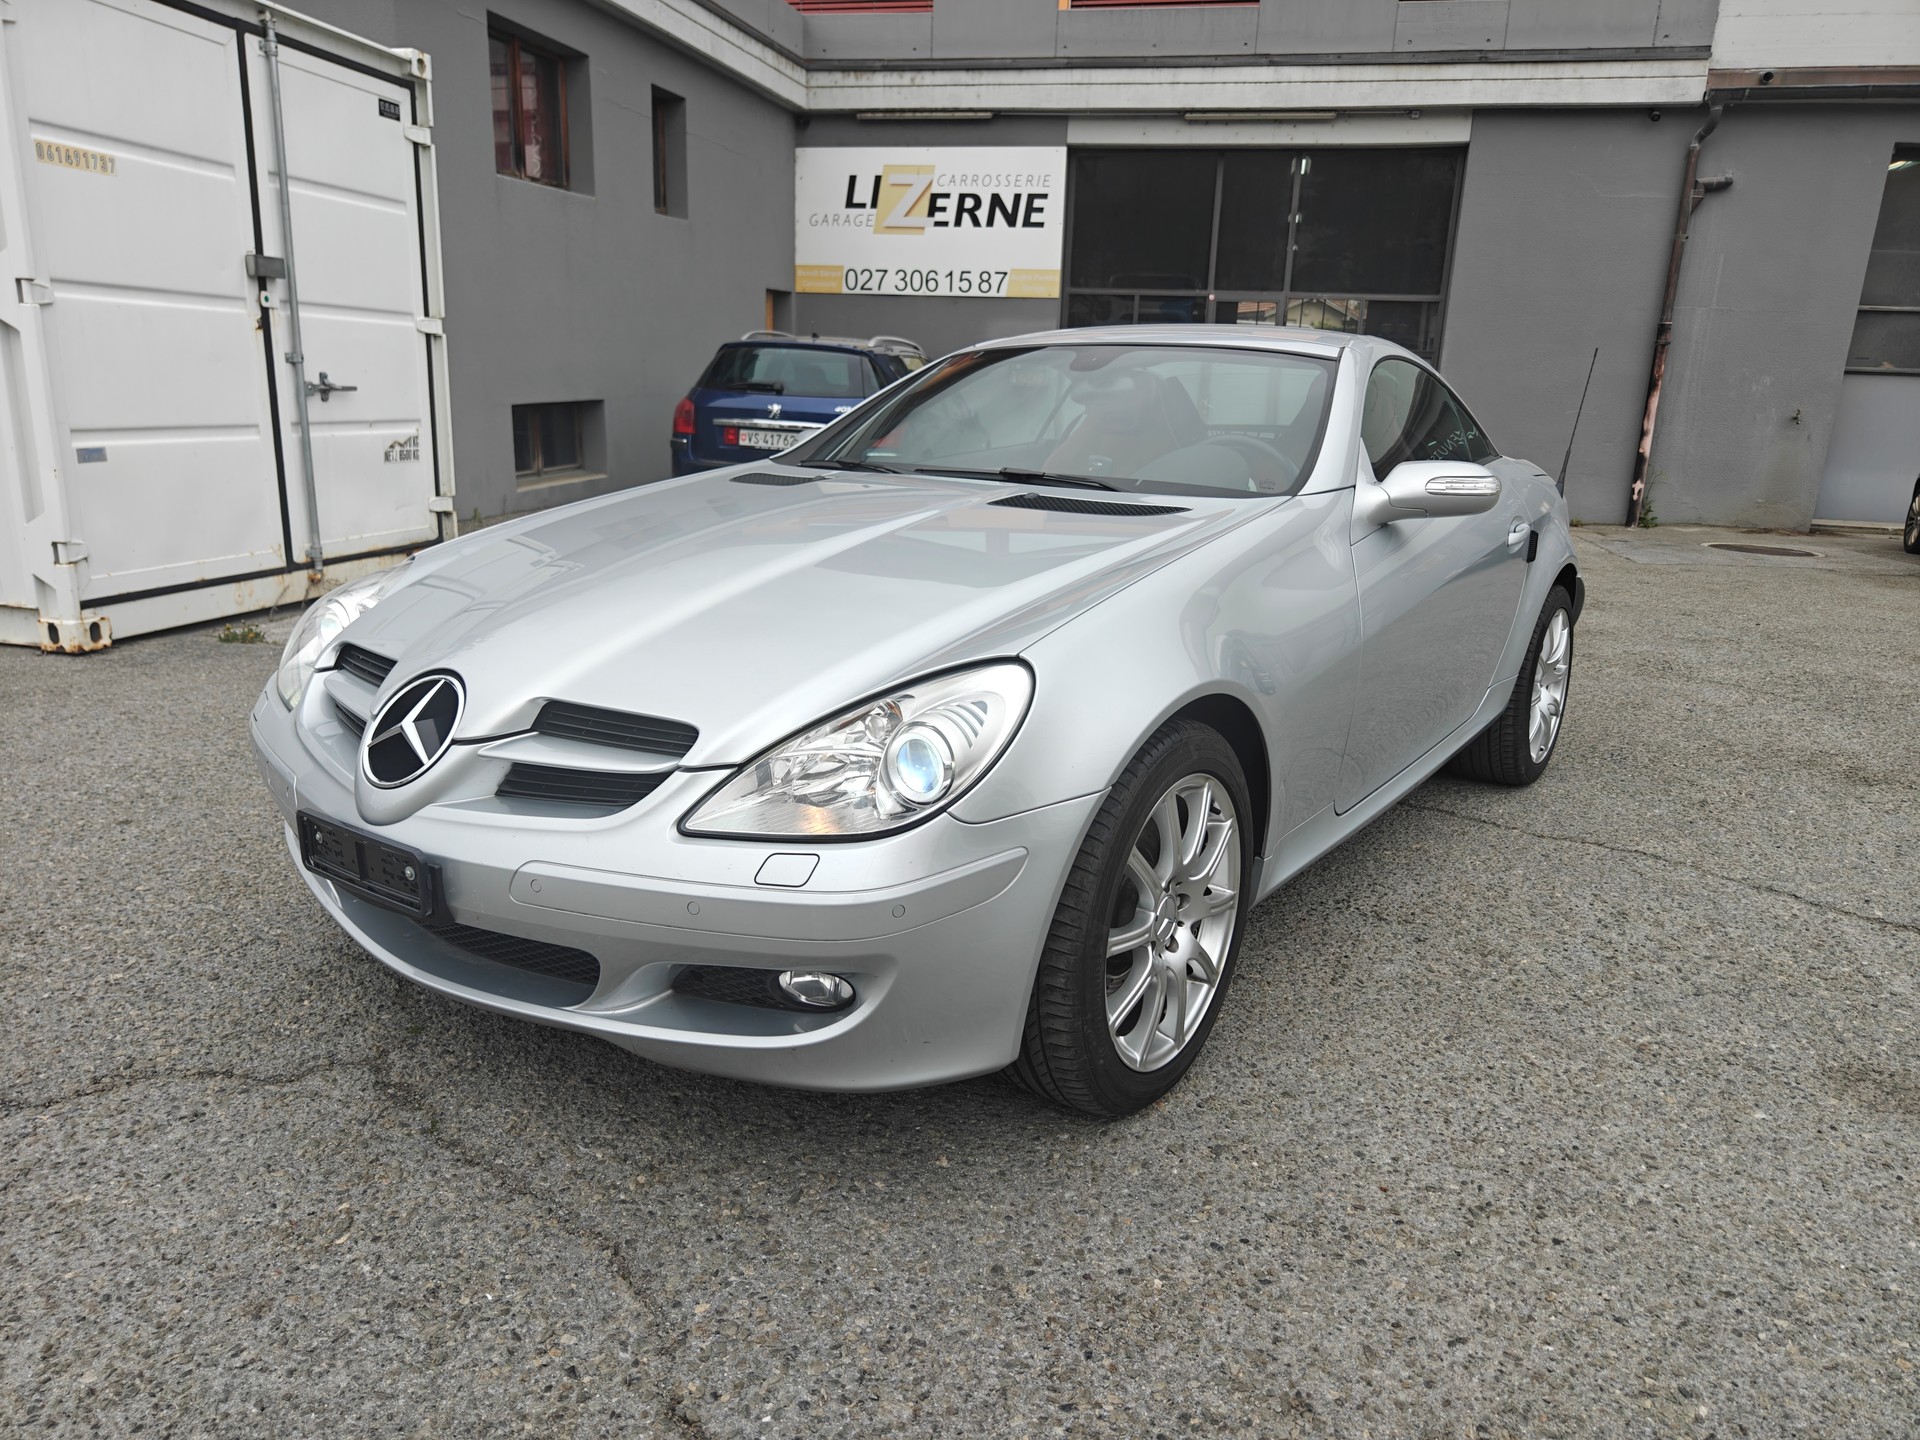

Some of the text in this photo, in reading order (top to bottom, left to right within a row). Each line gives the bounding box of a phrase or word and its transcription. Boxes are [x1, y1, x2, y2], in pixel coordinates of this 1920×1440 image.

[936, 173, 1051, 188] CARROSSERIE
[844, 172, 1049, 229] LIZERNE
[808, 212, 875, 228] GARAGE
[844, 267, 1009, 294] 027 306 15 87
